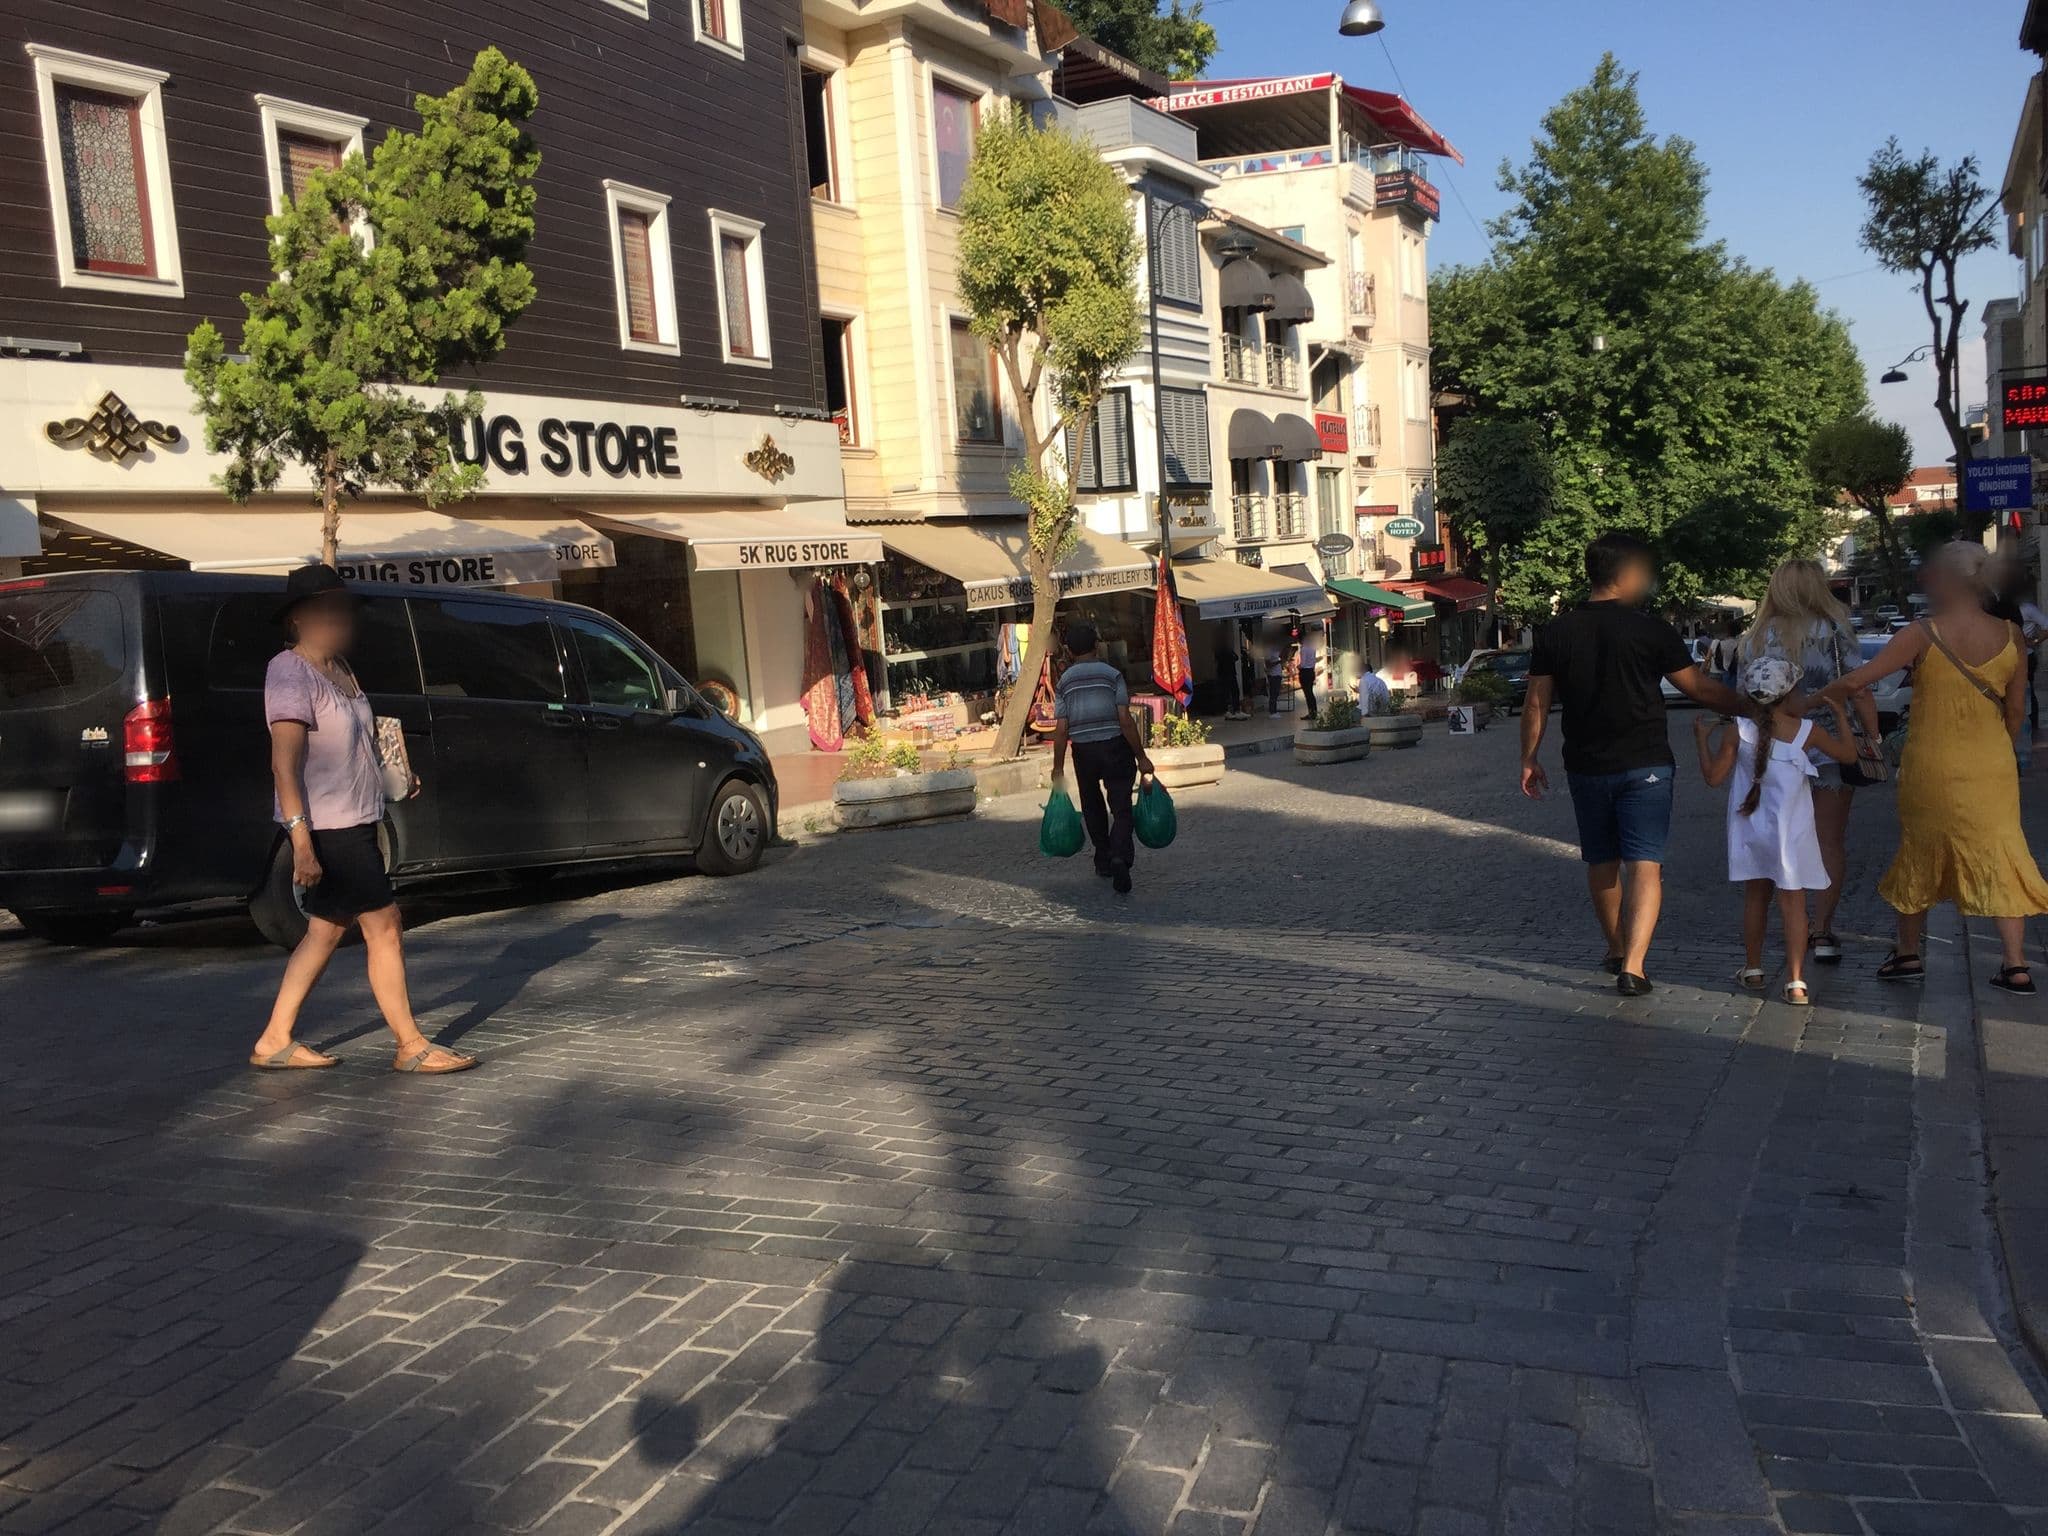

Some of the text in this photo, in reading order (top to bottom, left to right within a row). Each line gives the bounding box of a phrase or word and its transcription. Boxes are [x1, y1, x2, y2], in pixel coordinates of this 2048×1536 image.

[1155, 78, 1313, 110] TERRACE RESTAURANT
[447, 414, 682, 475] UG STORE
[1967, 463, 2030, 478] YOLCU İNDİRME
[1978, 479, 2018, 492] BİNDİRME
[1989, 495, 2008, 506] YERİ
[1390, 528, 1416, 536] HOTEL
[740, 542, 849, 564] 5K RUG STORE
[408, 557, 495, 584] STORE
[970, 586, 1004, 603] CAKUS
[1096, 569, 1141, 587] JEWELLERY
